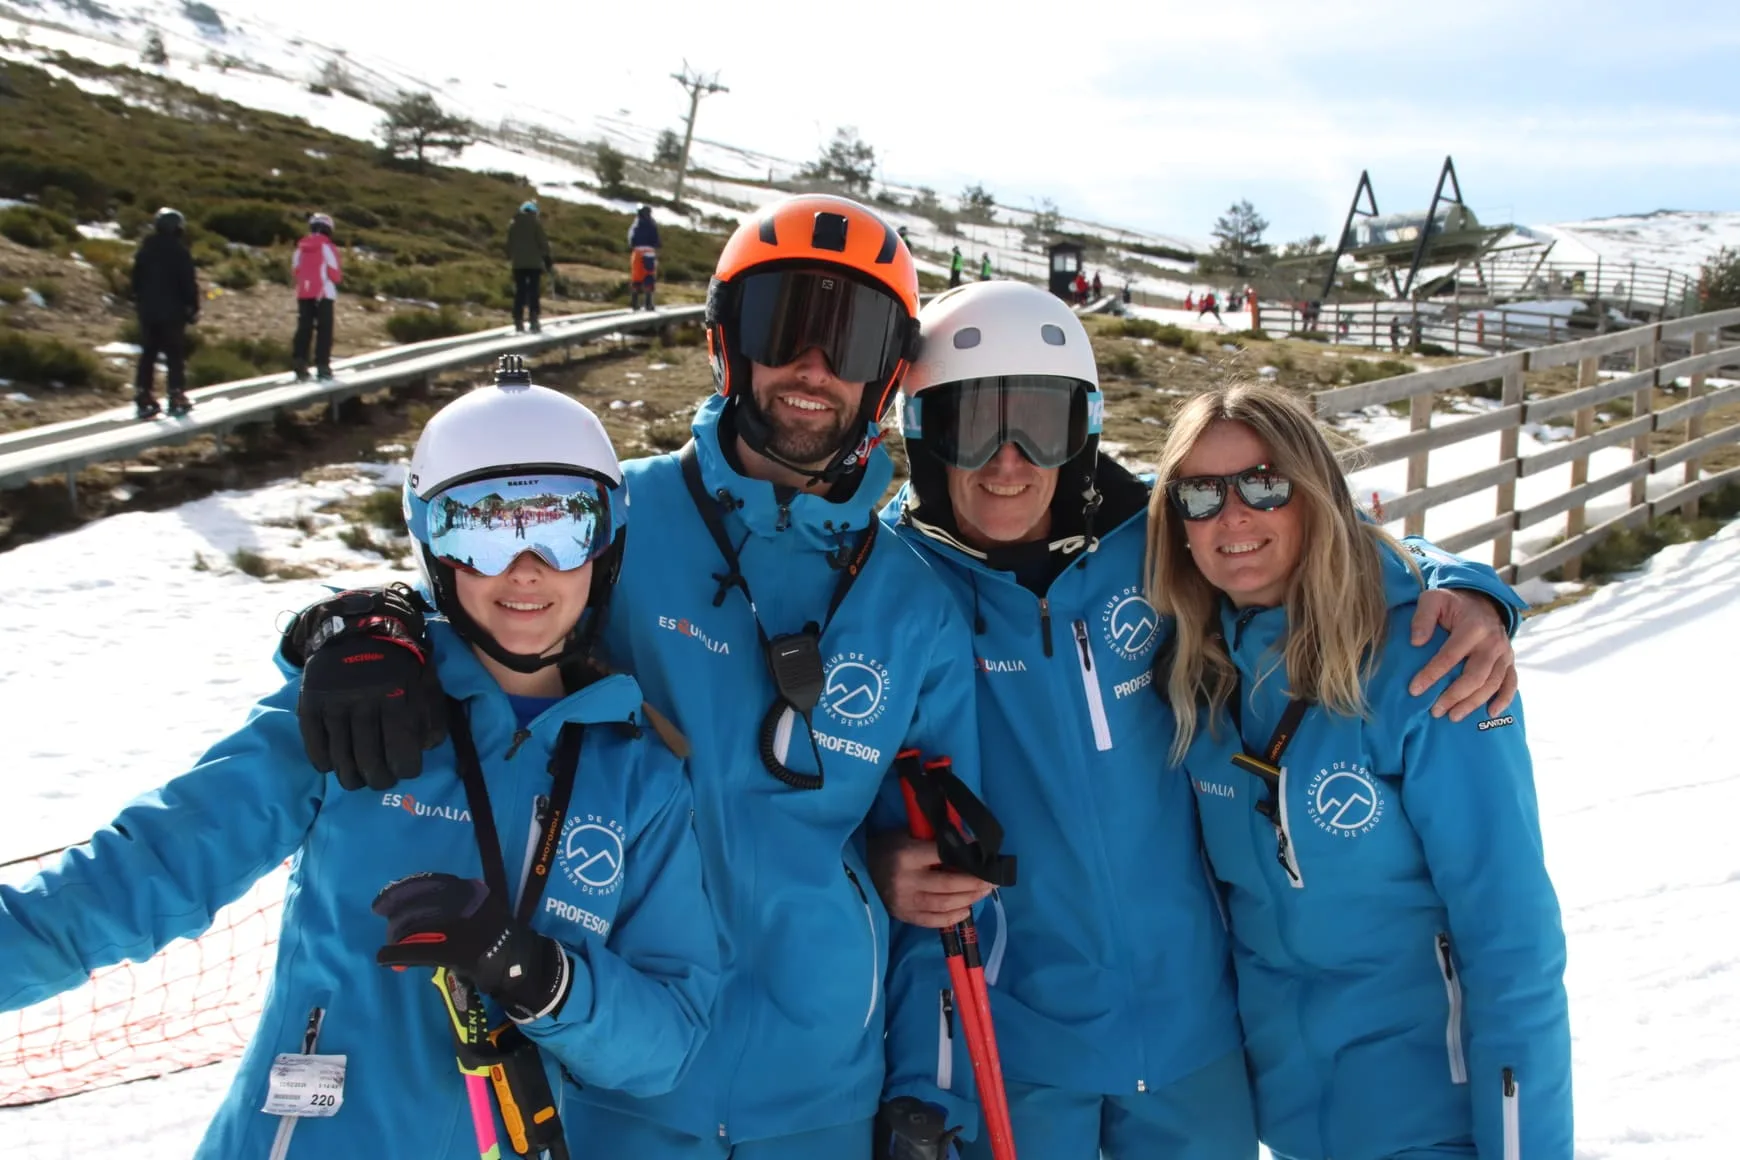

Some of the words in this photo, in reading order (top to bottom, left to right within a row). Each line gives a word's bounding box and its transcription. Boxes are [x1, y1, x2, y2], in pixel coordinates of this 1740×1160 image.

[1102, 595, 1119, 622] CLUB
[1123, 586, 1137, 595] DE
[658, 615, 730, 655] ESQUIALIA
[823, 653, 844, 674] CLUB
[849, 652, 865, 661] DE
[870, 659, 890, 690] ESQUI
[1113, 669, 1154, 700] PROFES
[820, 693, 837, 719] ERRA
[840, 718, 853, 727] DE
[857, 704, 885, 727] MADRID
[1308, 768, 1328, 796] CLUB
[1332, 761, 1346, 770] DE
[381, 793, 472, 822] ESQUIALIA
[1307, 808, 1338, 835] SIERRA
[1344, 829, 1357, 838] DE
[1361, 799, 1385, 834] MADRID
[561, 816, 581, 837] CLUB
[587, 814, 602, 823] DE
[556, 848, 579, 886] SIERRA
[582, 884, 593, 895] DE
[468, 1009, 478, 1043] LEKI
[310, 1094, 335, 1107] 220
